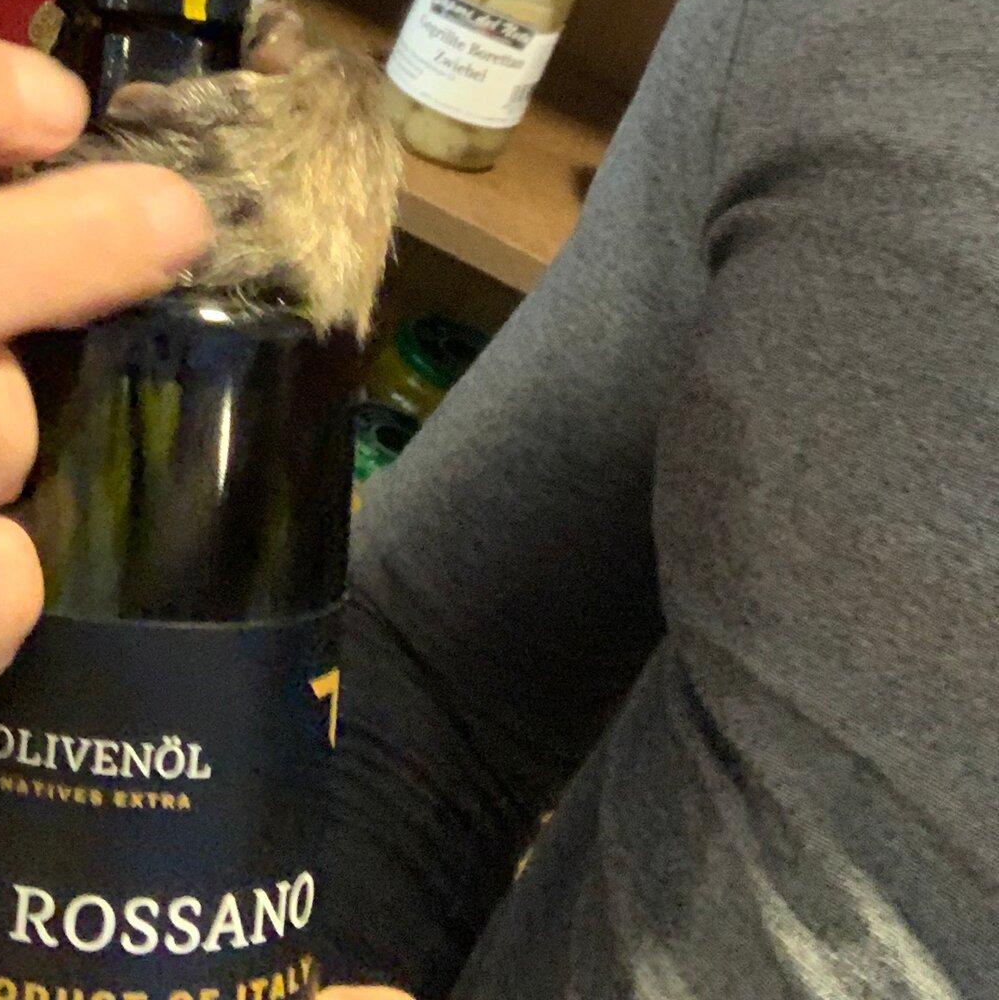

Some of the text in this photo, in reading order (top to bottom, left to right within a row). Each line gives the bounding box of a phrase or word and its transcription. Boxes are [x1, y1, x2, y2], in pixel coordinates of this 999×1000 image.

[433, 49, 488, 83] Zwiebel
[113, 789, 192, 811] EXTRA
[8, 870, 315, 956] ROSSANO
